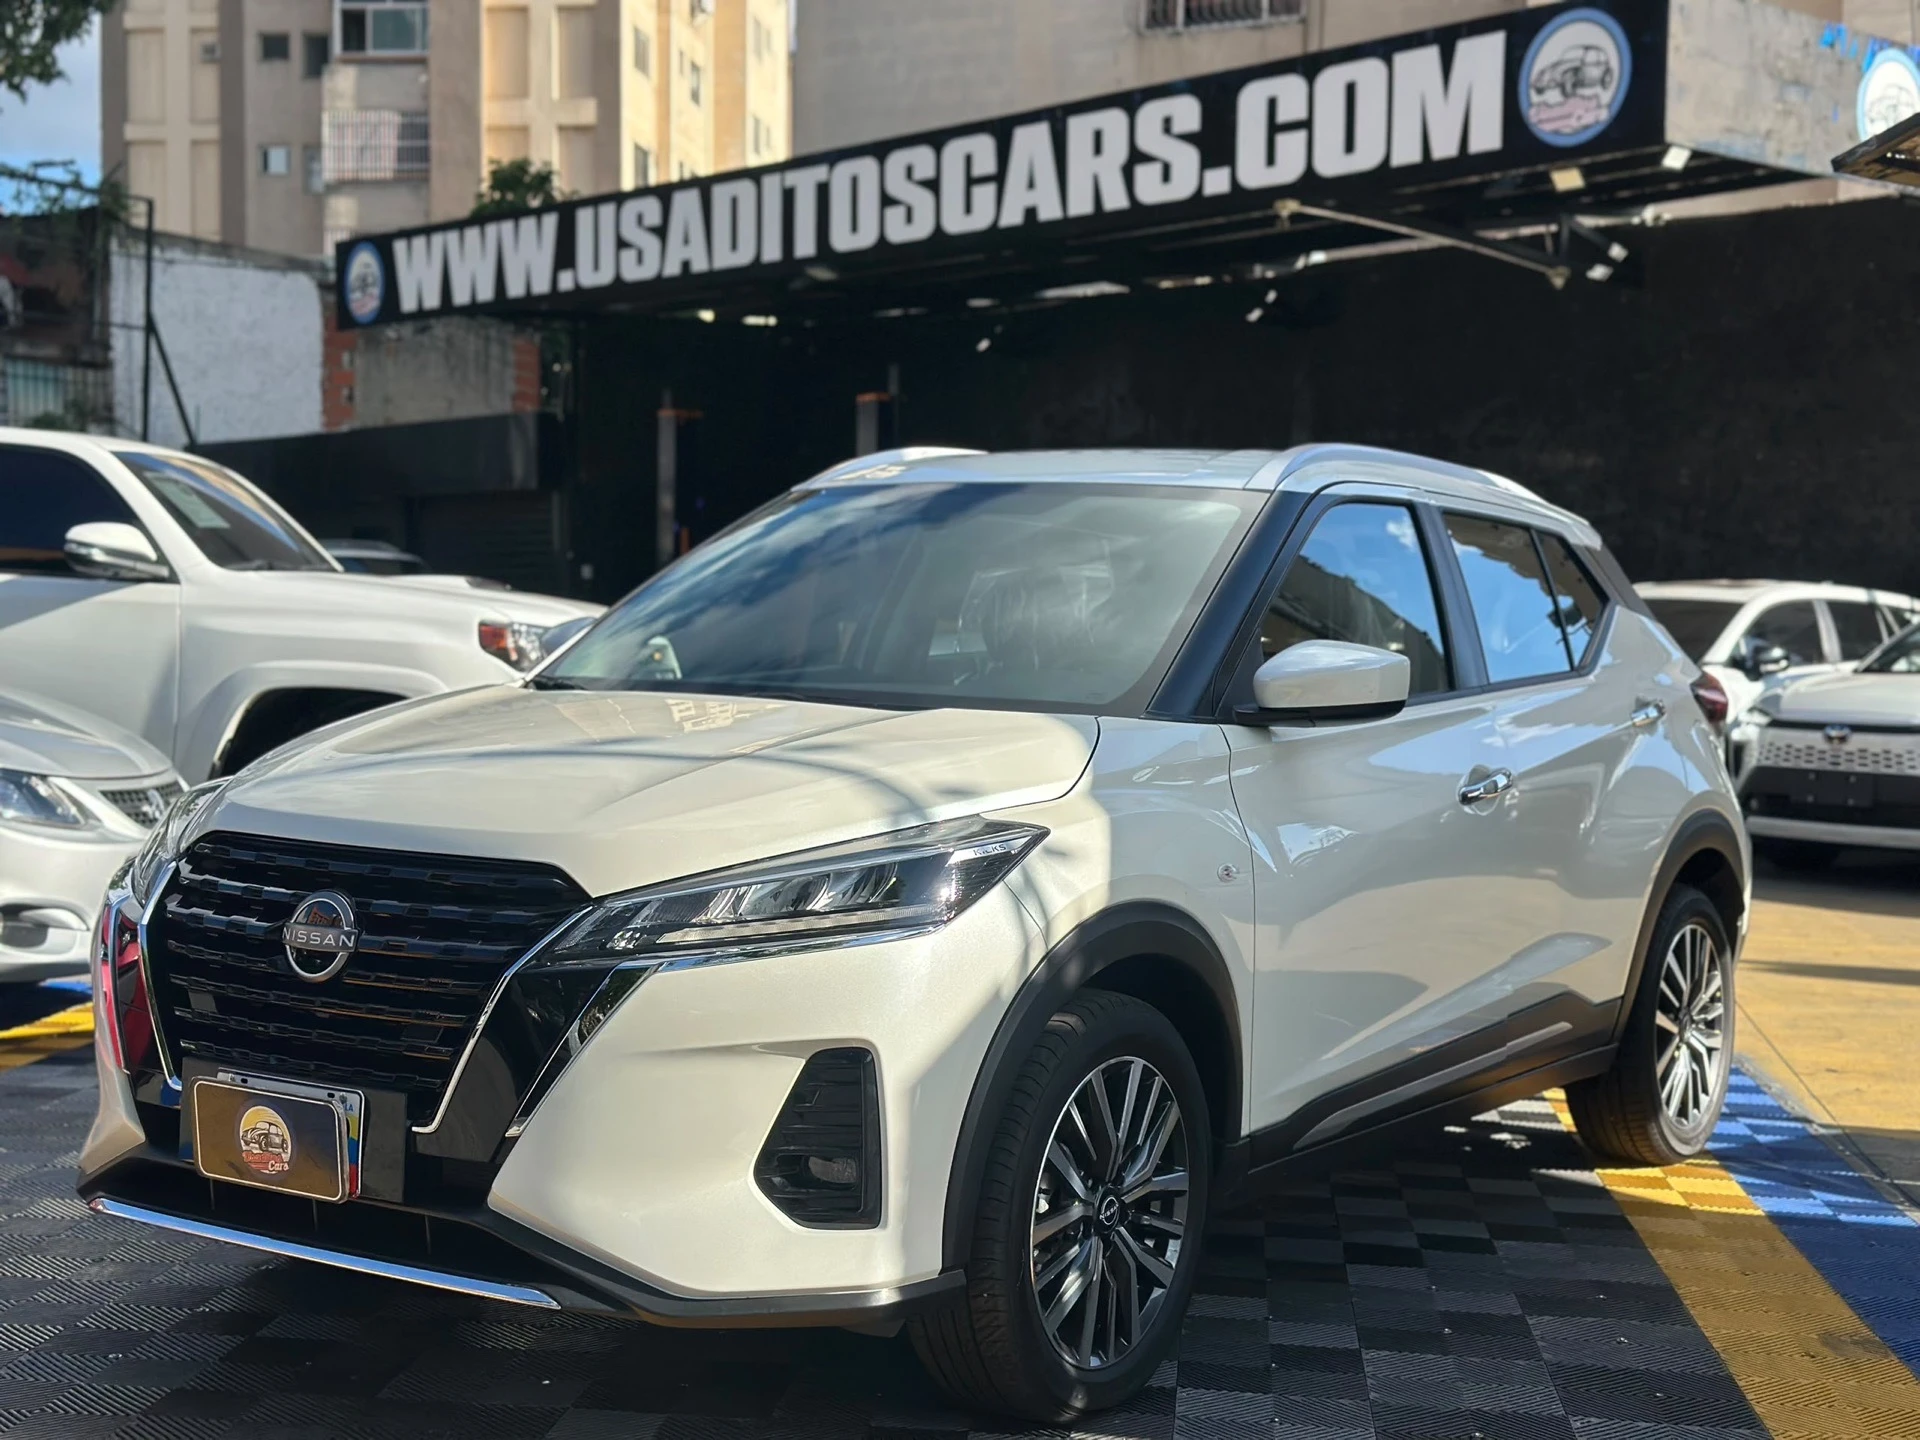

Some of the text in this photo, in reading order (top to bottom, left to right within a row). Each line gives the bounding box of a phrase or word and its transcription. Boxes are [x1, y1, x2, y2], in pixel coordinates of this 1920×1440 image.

[392, 29, 1507, 314] WWW.USADITOSCARS.COM
[973, 843, 1007, 856] KICKS
[282, 926, 355, 947] NISSAN
[268, 1160, 289, 1171] Cars
